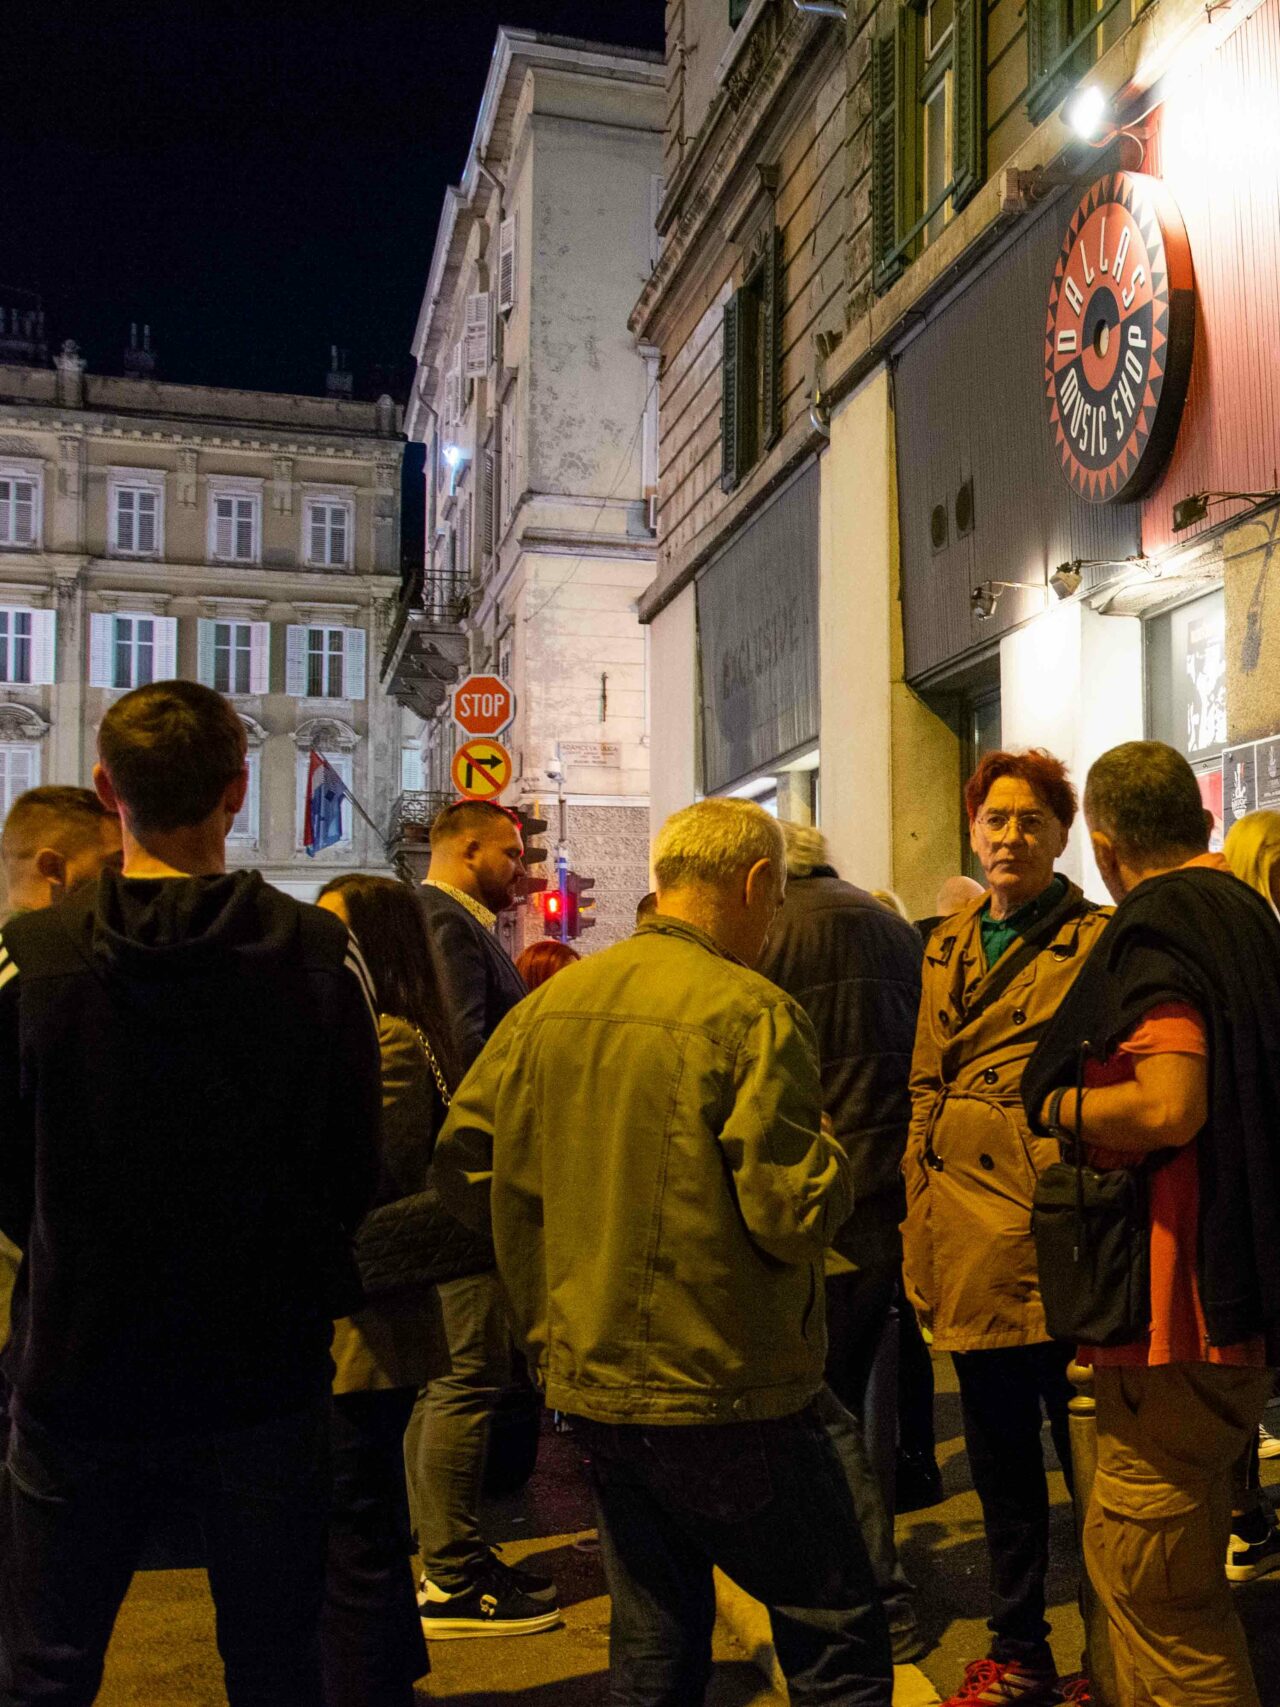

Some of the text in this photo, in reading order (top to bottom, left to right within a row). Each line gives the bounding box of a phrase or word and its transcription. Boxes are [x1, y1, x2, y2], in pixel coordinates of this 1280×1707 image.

[1057, 215, 1146, 354] DALLAS
[1060, 324, 1147, 457] MUSIC SHOP
[460, 693, 505, 718] STOP
